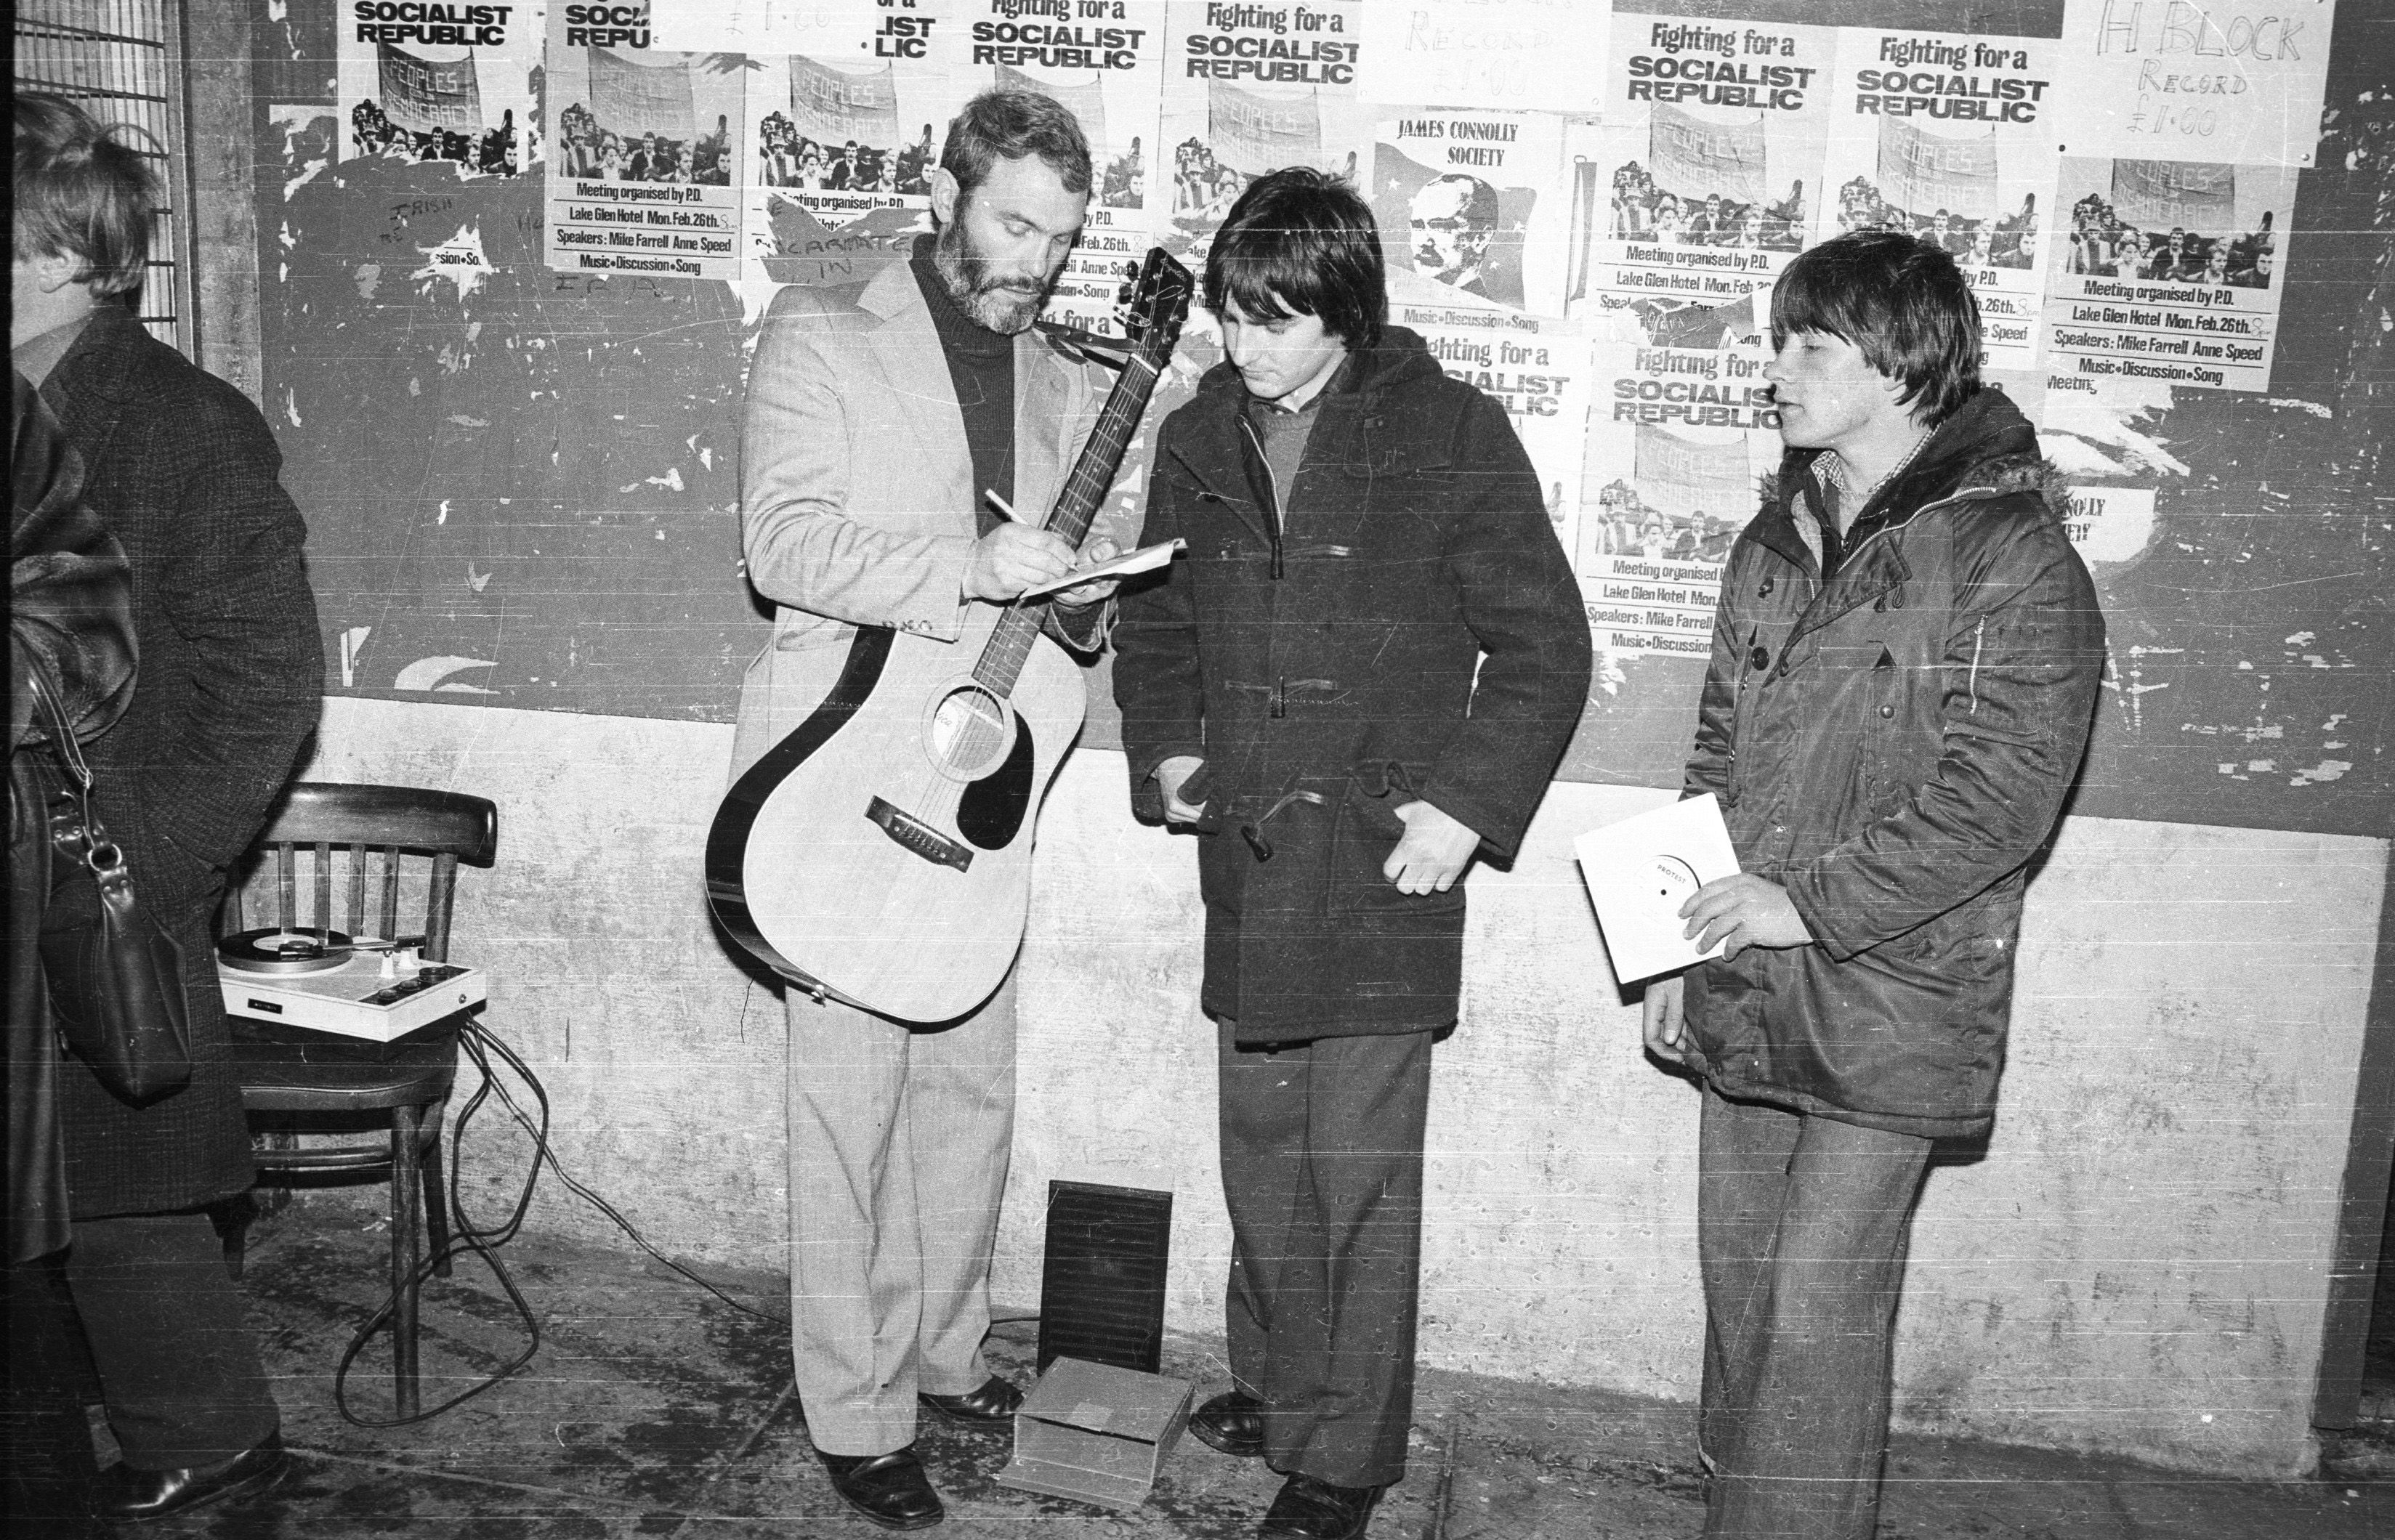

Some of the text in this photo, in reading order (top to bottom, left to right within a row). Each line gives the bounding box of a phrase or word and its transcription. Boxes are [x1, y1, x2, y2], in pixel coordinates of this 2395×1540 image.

[355, 1, 513, 26] SOCIALIST
[1111, 1, 1126, 20] a
[1206, 1, 1344, 35] Fighting for a
[357, 23, 505, 46] REPUBLIC
[972, 21, 1146, 49] SOCIALIST
[1651, 23, 1795, 58] Fighting for a
[2097, 0, 2305, 61] H BLOCK
[973, 44, 1136, 70] REPUBLIC
[1186, 34, 1360, 63] SOCIALIST
[1880, 36, 2028, 71] Fighting for a
[1186, 58, 1354, 84] REPUBLIC
[1628, 55, 1817, 89] SOCIALIST
[2138, 58, 2247, 94] RECORD
[1627, 79, 1804, 110] REPUBLIC
[1856, 69, 2050, 102] SOCIALIST
[1855, 93, 2037, 123] REPUBLIC
[2127, 93, 2217, 137] £1.00
[1397, 120, 1519, 142] JAMES CONNOLLY
[1447, 147, 1505, 166] SOCIETY
[576, 183, 703, 204] Meeting organised by P.D.
[821, 195, 872, 211] organised
[570, 207, 593, 221] Lake
[594, 208, 615, 222] Glen
[618, 208, 643, 224] Hotel
[1096, 211, 1113, 225] P.D.
[557, 229, 732, 254] Speakers: Mike Farrell Anne Speed
[1081, 260, 1107, 275] Anne
[1626, 246, 1769, 271] Meeting organised by P.D.
[1616, 271, 1642, 286] Lake
[1644, 272, 1668, 288] Glen
[1671, 275, 1700, 291] Hotel
[1979, 270, 1998, 285] P.D.
[2084, 280, 2234, 307] Meeting organised by P.D.
[1097, 317, 1111, 334] a
[2072, 306, 2100, 322] Lake
[2102, 307, 2128, 324] Glen
[2130, 309, 2161, 327] Hotel
[1991, 324, 2028, 341] Speed
[1424, 336, 1549, 368] ghting for a
[2054, 329, 2263, 362] Speakers: Mike Farrell Anne Speed
[1635, 348, 1759, 380] Fighting for
[1495, 394, 1559, 417] LIC
[1614, 378, 1777, 408] SOCIALIS
[1613, 401, 1783, 430] REPUBLIC
[1612, 560, 1660, 580] Meeting
[1662, 566, 1718, 582] organised
[1603, 584, 1629, 599] Lake
[1631, 586, 1655, 601] Glen
[1657, 588, 1686, 604] Hotel
[1646, 611, 1674, 627] Mike
[1676, 614, 1713, 630] Farrell
[1657, 864, 1687, 884] PROTEST
